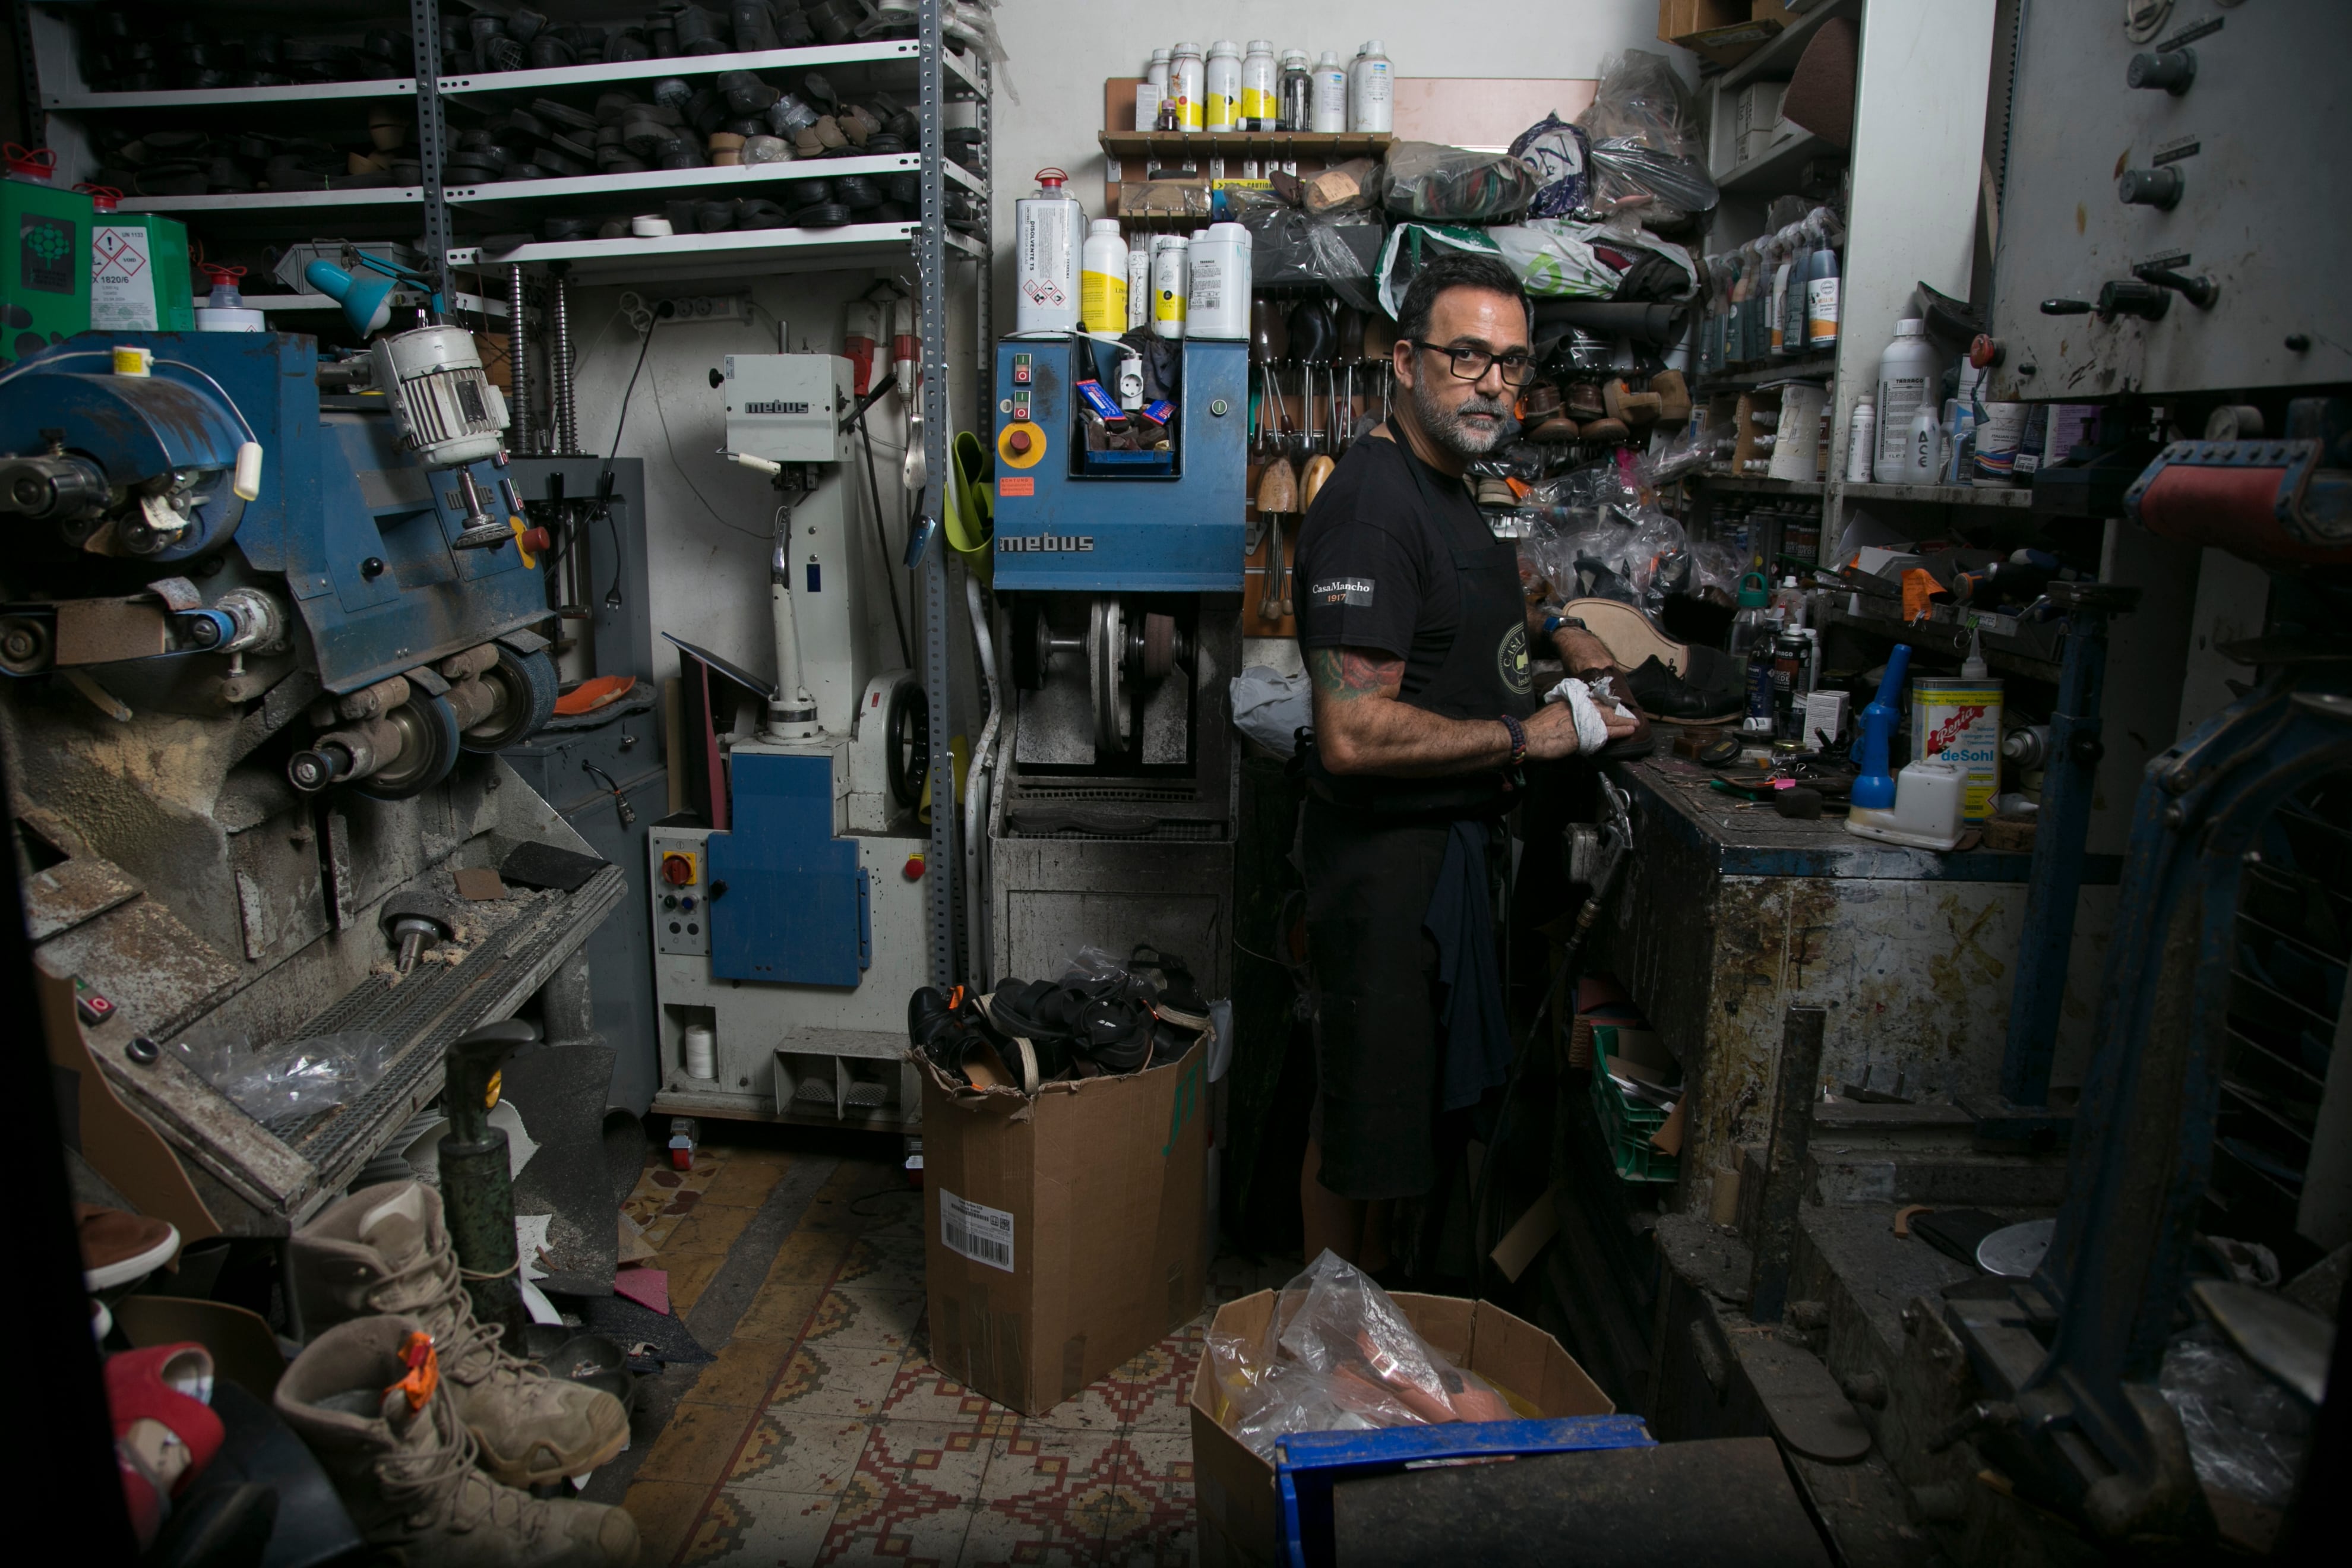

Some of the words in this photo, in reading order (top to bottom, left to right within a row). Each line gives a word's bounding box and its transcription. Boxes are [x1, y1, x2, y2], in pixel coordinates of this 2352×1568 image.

[745, 399, 808, 413] mebus
[1000, 532, 1093, 552] mebus
[1312, 581, 1370, 594] CasaMancho
[1327, 593, 1346, 602] 1917
[1936, 707, 1975, 746] Renia
[1941, 750, 1994, 761] deSohl
